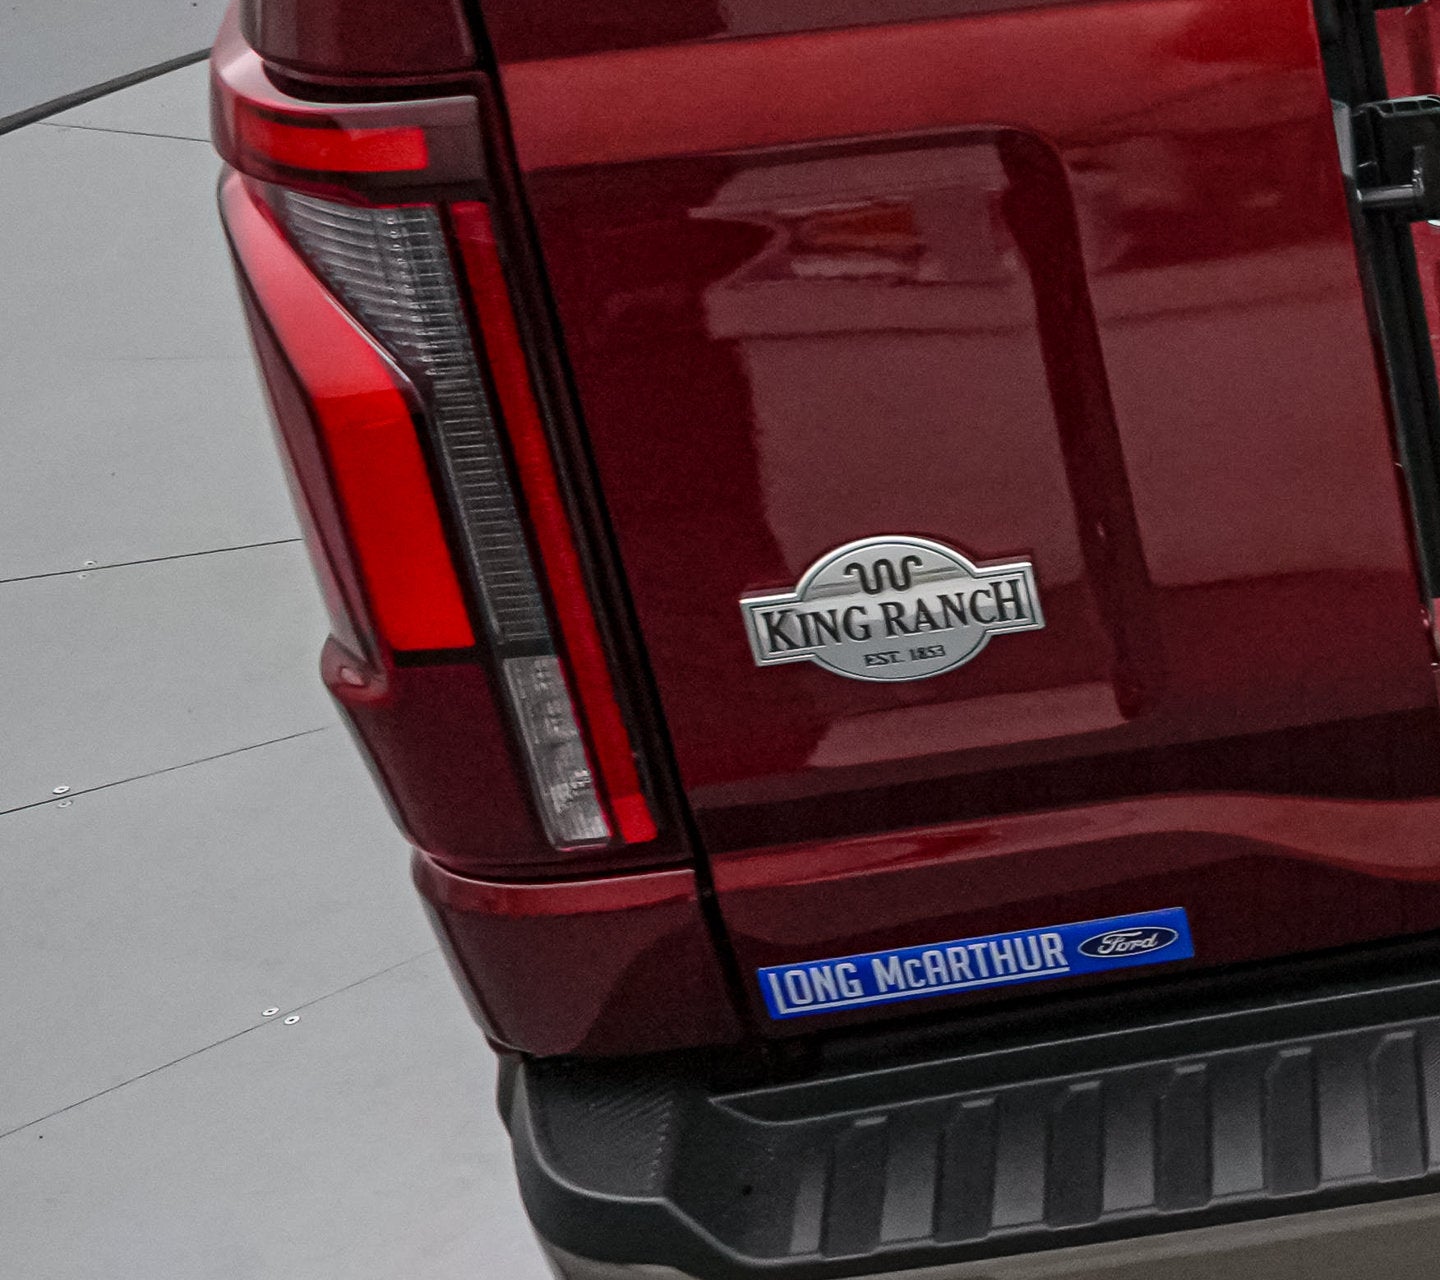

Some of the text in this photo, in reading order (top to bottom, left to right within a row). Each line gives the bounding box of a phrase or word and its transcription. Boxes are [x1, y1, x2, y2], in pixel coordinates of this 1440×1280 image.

[761, 578, 1026, 653] KING RANCH
[768, 961, 864, 1015] LONG
[1097, 931, 1158, 954] Ford
